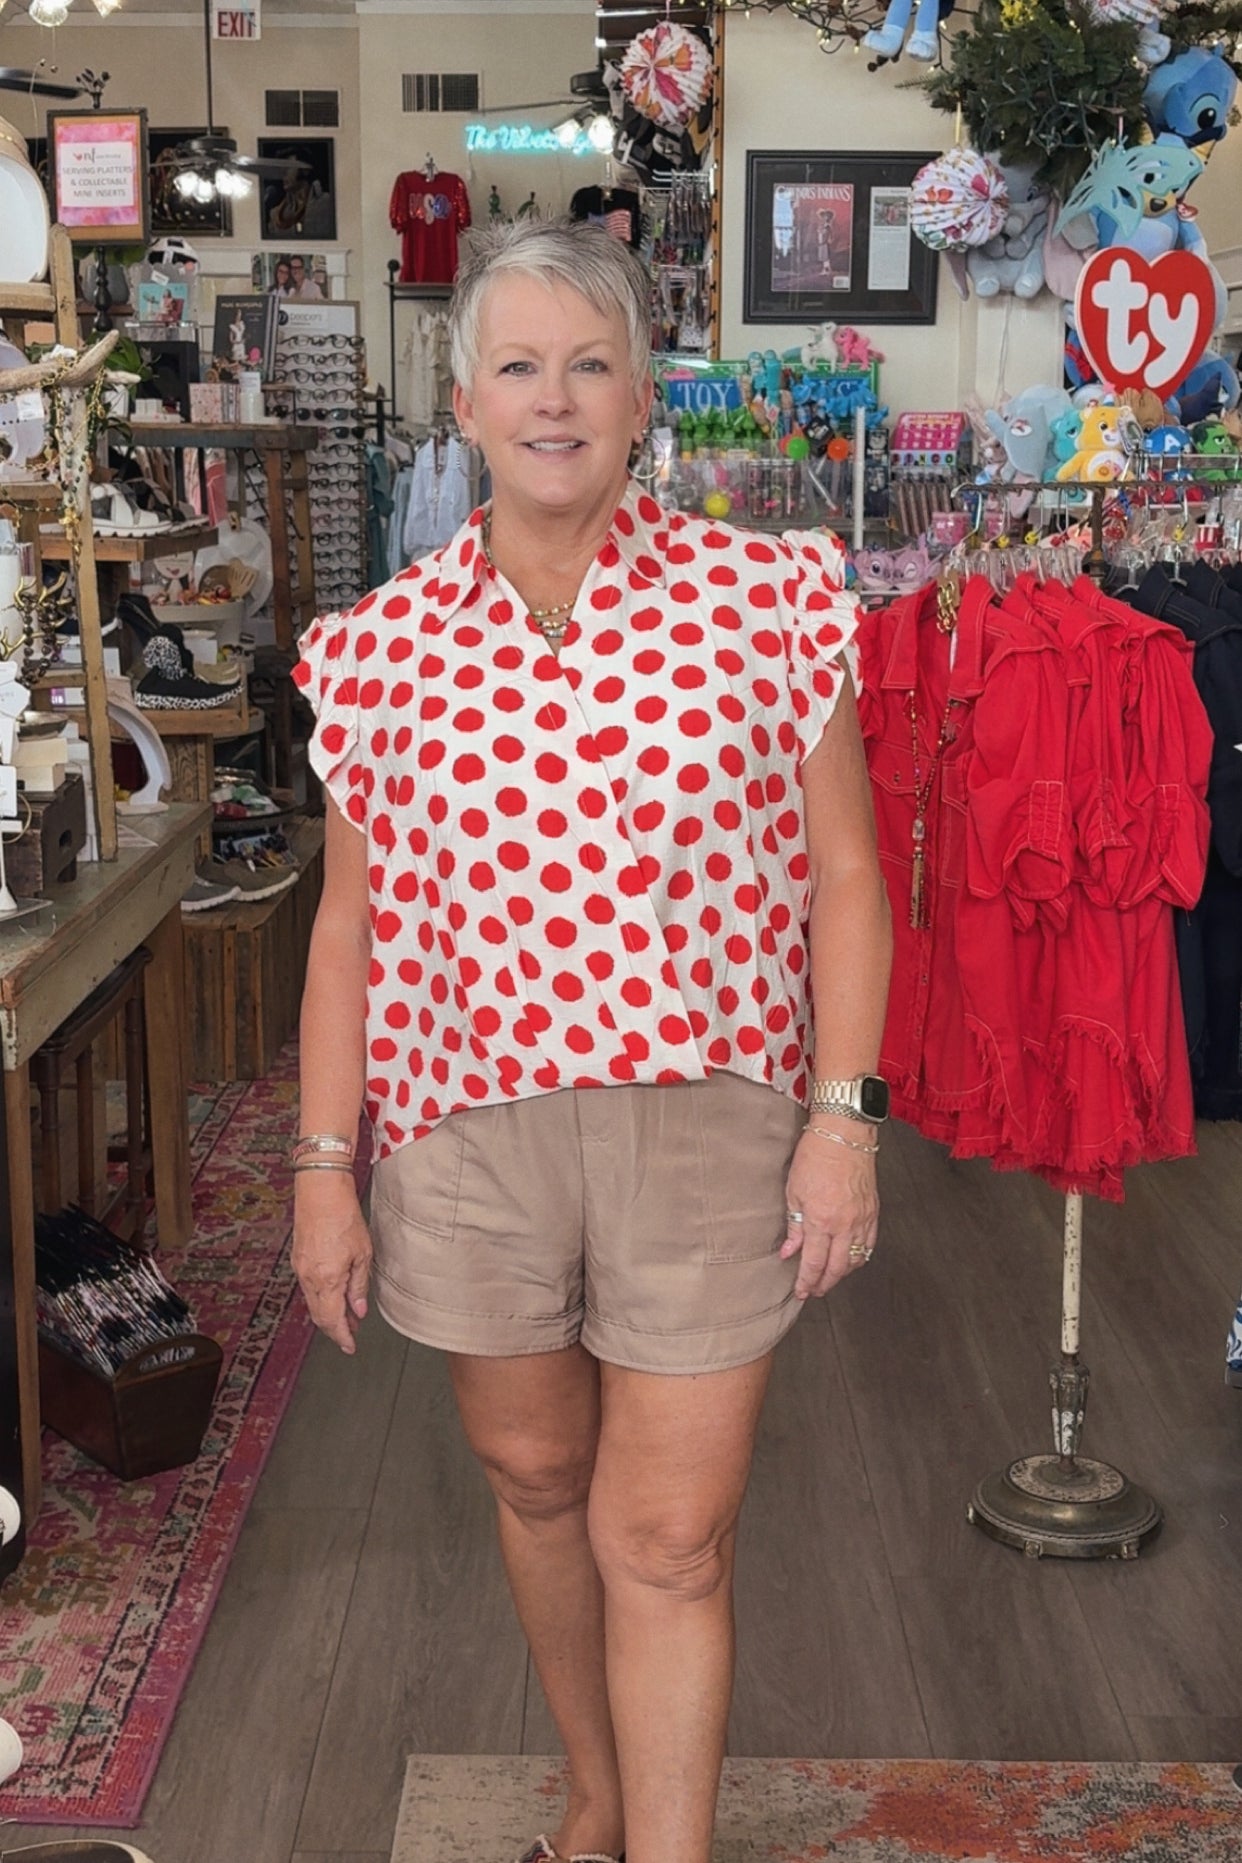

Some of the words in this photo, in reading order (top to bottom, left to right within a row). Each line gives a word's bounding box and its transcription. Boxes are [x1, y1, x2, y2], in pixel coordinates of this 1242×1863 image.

[218, 11, 256, 37] EXIT
[79, 178, 126, 186] COLLECTABLE
[97, 166, 132, 174] PLATTERS
[1092, 259, 1200, 389] ty
[677, 382, 733, 411] TOY
